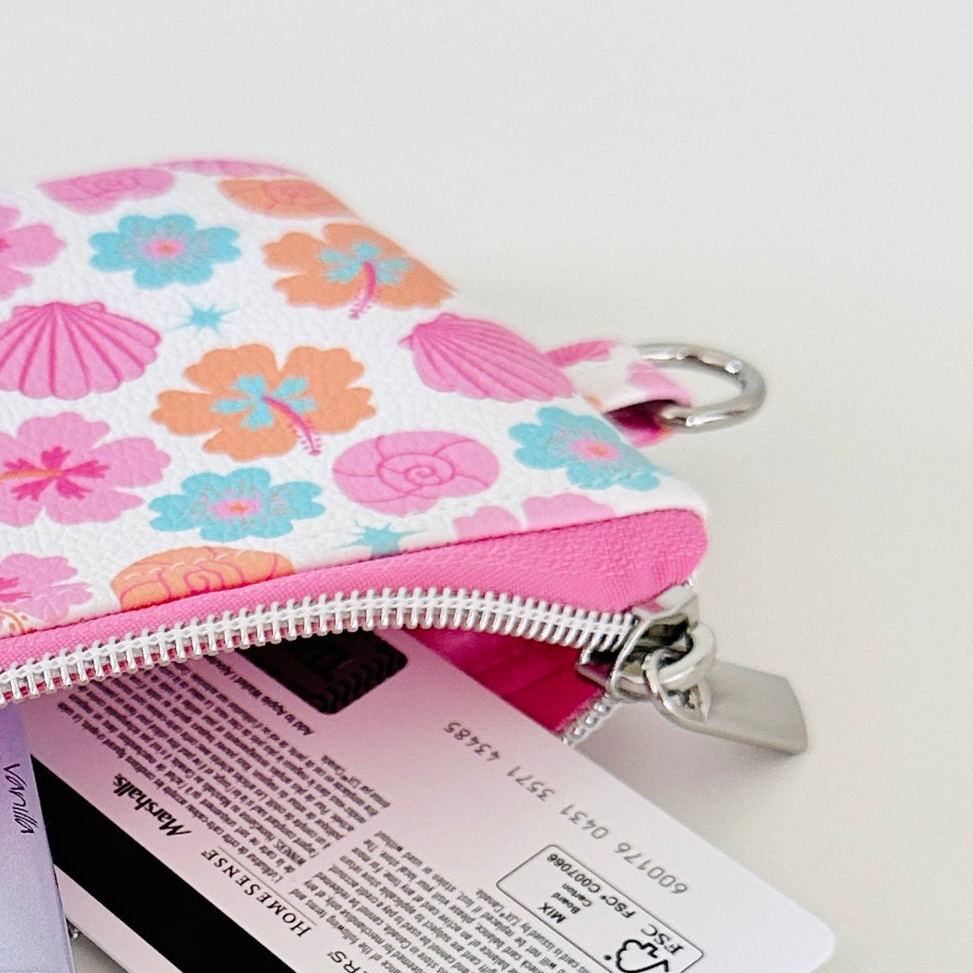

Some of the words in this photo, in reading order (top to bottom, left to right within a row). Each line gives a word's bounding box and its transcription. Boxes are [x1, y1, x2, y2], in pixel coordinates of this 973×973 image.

[441, 720, 502, 762] 43485
[3, 763, 39, 834] Vanilla
[504, 765, 556, 802] 3571
[109, 775, 192, 839] Marshalls
[558, 803, 610, 840] 0431
[545, 852, 602, 893] C007066
[611, 841, 689, 895] 600176
[537, 901, 566, 923] MIX
[550, 891, 581, 914] Board
[560, 882, 593, 907] Carton
[639, 923, 684, 955] FSC
